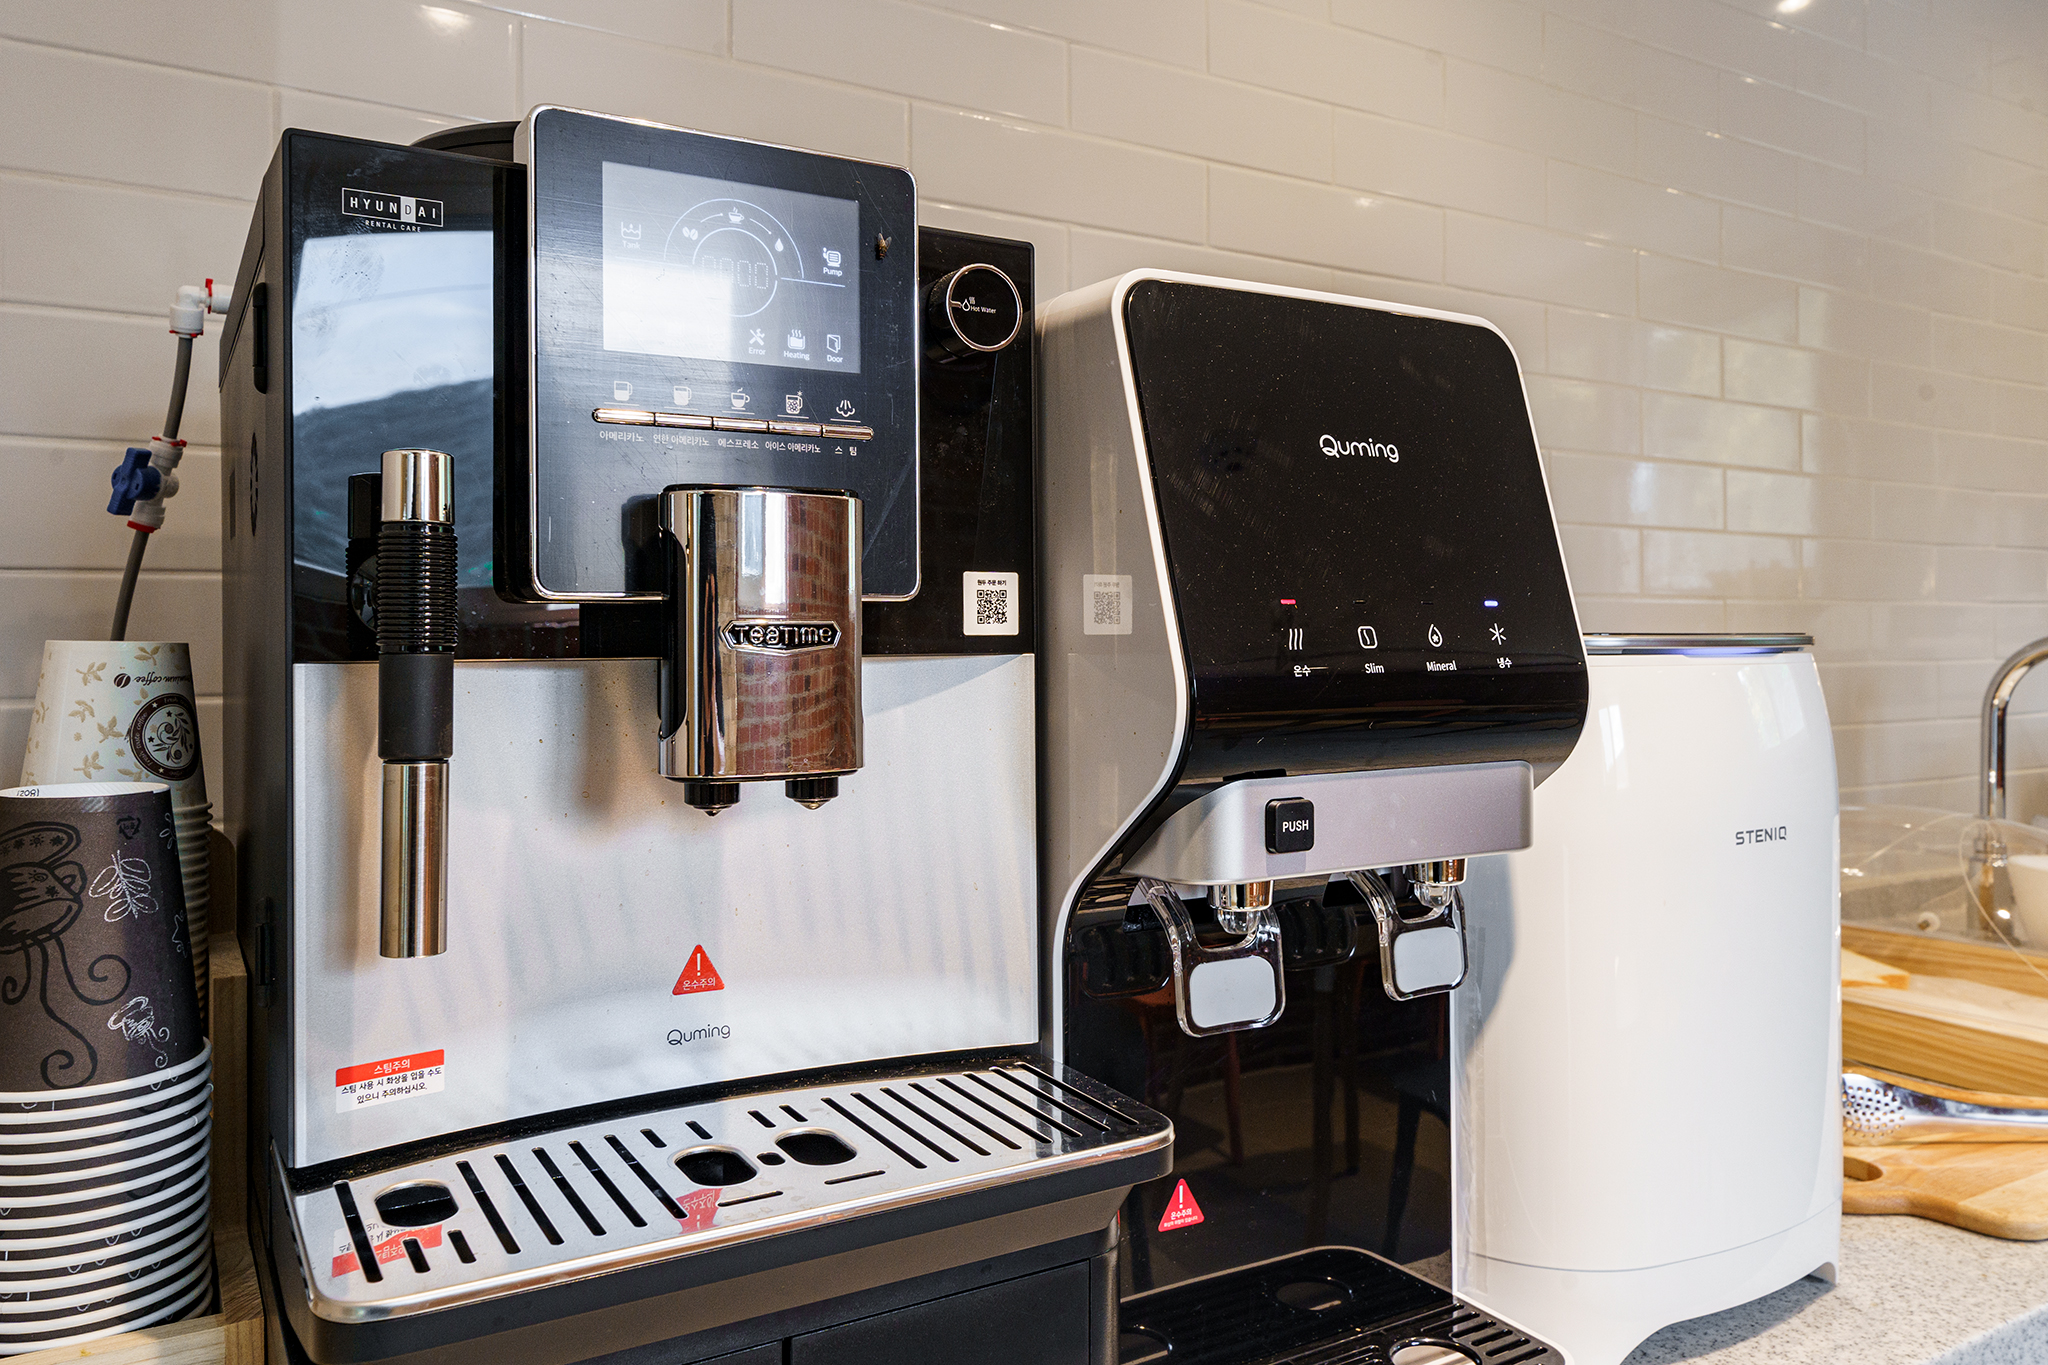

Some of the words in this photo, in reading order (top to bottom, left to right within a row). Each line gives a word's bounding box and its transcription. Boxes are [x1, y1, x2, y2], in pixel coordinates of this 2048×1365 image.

[350, 196, 436, 219] HYUNDAI
[365, 220, 397, 230] RENTAL
[400, 224, 422, 233] CARE
[622, 240, 641, 250] Tank
[822, 266, 843, 277] Pump
[748, 346, 767, 356] Error
[783, 350, 810, 361] Heating
[826, 354, 844, 364] Door
[599, 430, 644, 442] 아메리카노
[653, 433, 669, 444] 연한
[671, 435, 710, 447] 아메리카노
[717, 438, 760, 450] 에스프레소
[765, 440, 786, 451] 아이스
[787, 442, 821, 454] 아메리카노
[1319, 434, 1400, 464] Quming
[1365, 662, 1385, 674] Slim
[1426, 660, 1457, 672] Mineral
[1497, 657, 1512, 669] 냉수
[1293, 665, 1311, 677] 온수
[1282, 819, 1309, 833] PUSH
[1735, 825, 1787, 846] STENIQ
[682, 977, 716, 991] 온수주의
[666, 1023, 731, 1046] Quming
[373, 1058, 411, 1075] 스팀주의
[341, 1084, 357, 1095] 스팀
[359, 1080, 374, 1091] 사용
[376, 1079, 384, 1087] 시
[386, 1073, 408, 1085] 화상을
[410, 1069, 425, 1080] 입을
[427, 1066, 442, 1077] 수도
[356, 1091, 380, 1105] 있으니
[1171, 1208, 1192, 1220] 온수주의
